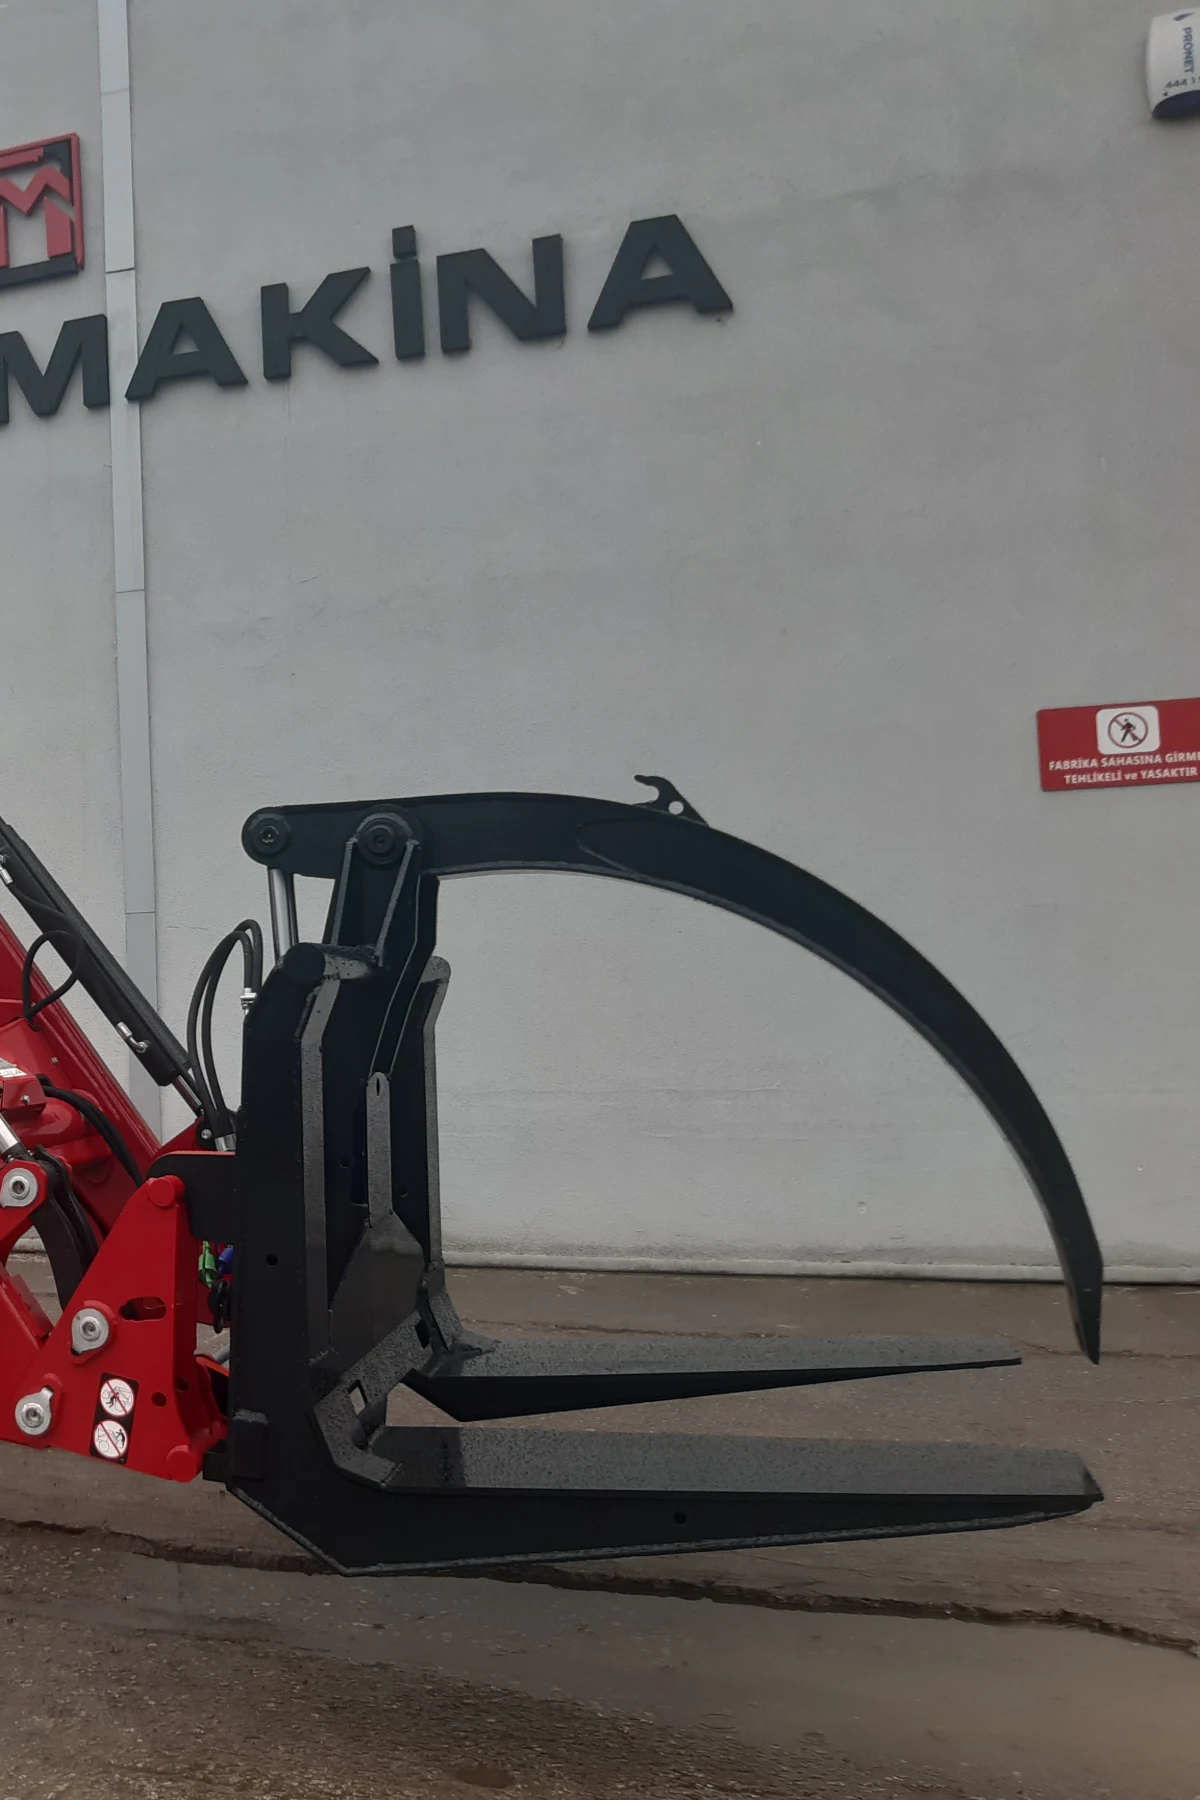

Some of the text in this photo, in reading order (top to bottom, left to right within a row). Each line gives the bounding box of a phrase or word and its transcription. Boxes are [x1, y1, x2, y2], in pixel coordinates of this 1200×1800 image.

[1049, 757, 1099, 771] FABRİKA
[1101, 753, 1162, 768] SAHASINA
[1064, 767, 1198, 784] TEHLİKELİ ve YASAKTIR
